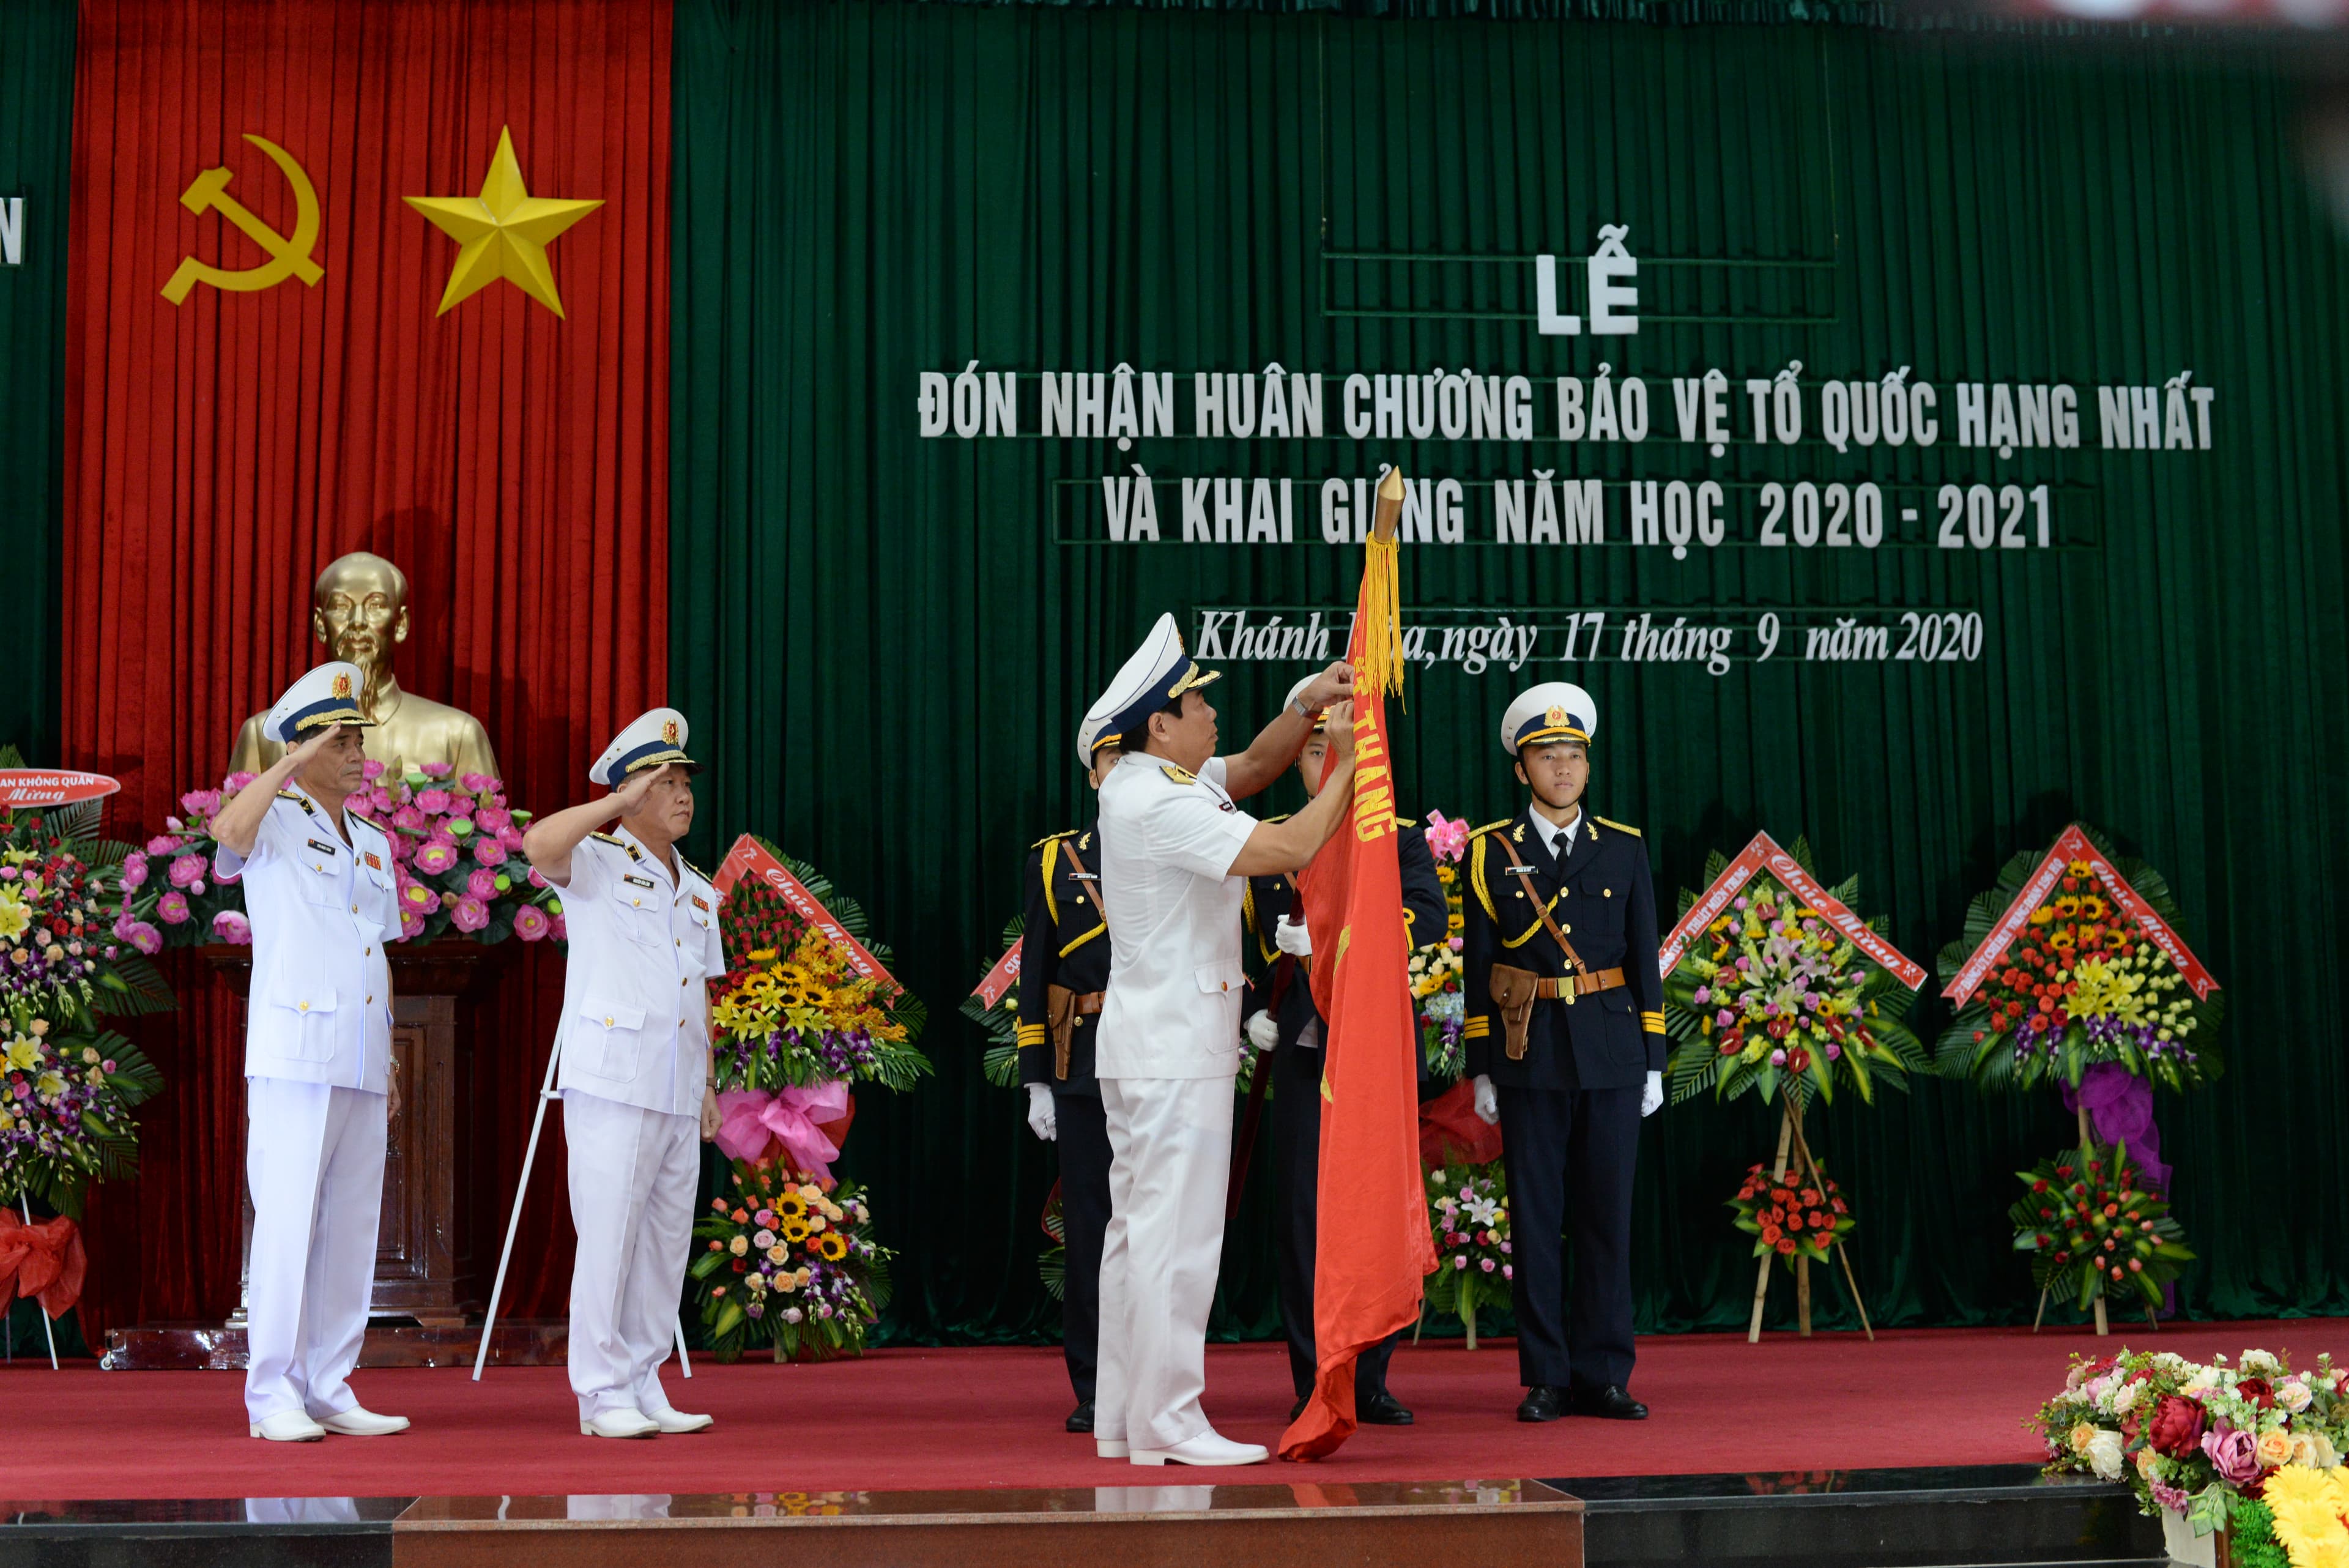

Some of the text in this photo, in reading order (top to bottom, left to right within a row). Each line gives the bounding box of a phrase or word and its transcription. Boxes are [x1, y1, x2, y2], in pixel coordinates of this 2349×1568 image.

[1536, 223, 1639, 335] LỄ
[917, 360, 2214, 459] ĐÓN NHẬN HUÂN CHƯƠNG BẢO VỆ TỔ QUỐC HẠNG NHẤT
[1102, 463, 1160, 541] VÀ
[1182, 477, 1293, 543] KHAI
[1494, 469, 1604, 544] NĂM
[1630, 480, 1724, 560] HỌC
[1761, 481, 1883, 548] 2020
[1902, 509, 1918, 521] -
[1938, 484, 2049, 549] 2021
[1192, 610, 1329, 661] Khánh
[1559, 612, 1605, 661] 17
[1621, 612, 1733, 675] tháng
[1757, 612, 1780, 662] 9
[1805, 617, 1889, 661] năm
[1895, 612, 1983, 662] 2020
[2, 788, 66, 803] Mừng
[18, 775, 59, 787] KHÔNG
[61, 773, 94, 788] QUÂN
[766, 868, 815, 915] Chúc
[1772, 855, 1902, 968] Chúc Mừng
[2090, 861, 2189, 968] Chúc Mừng
